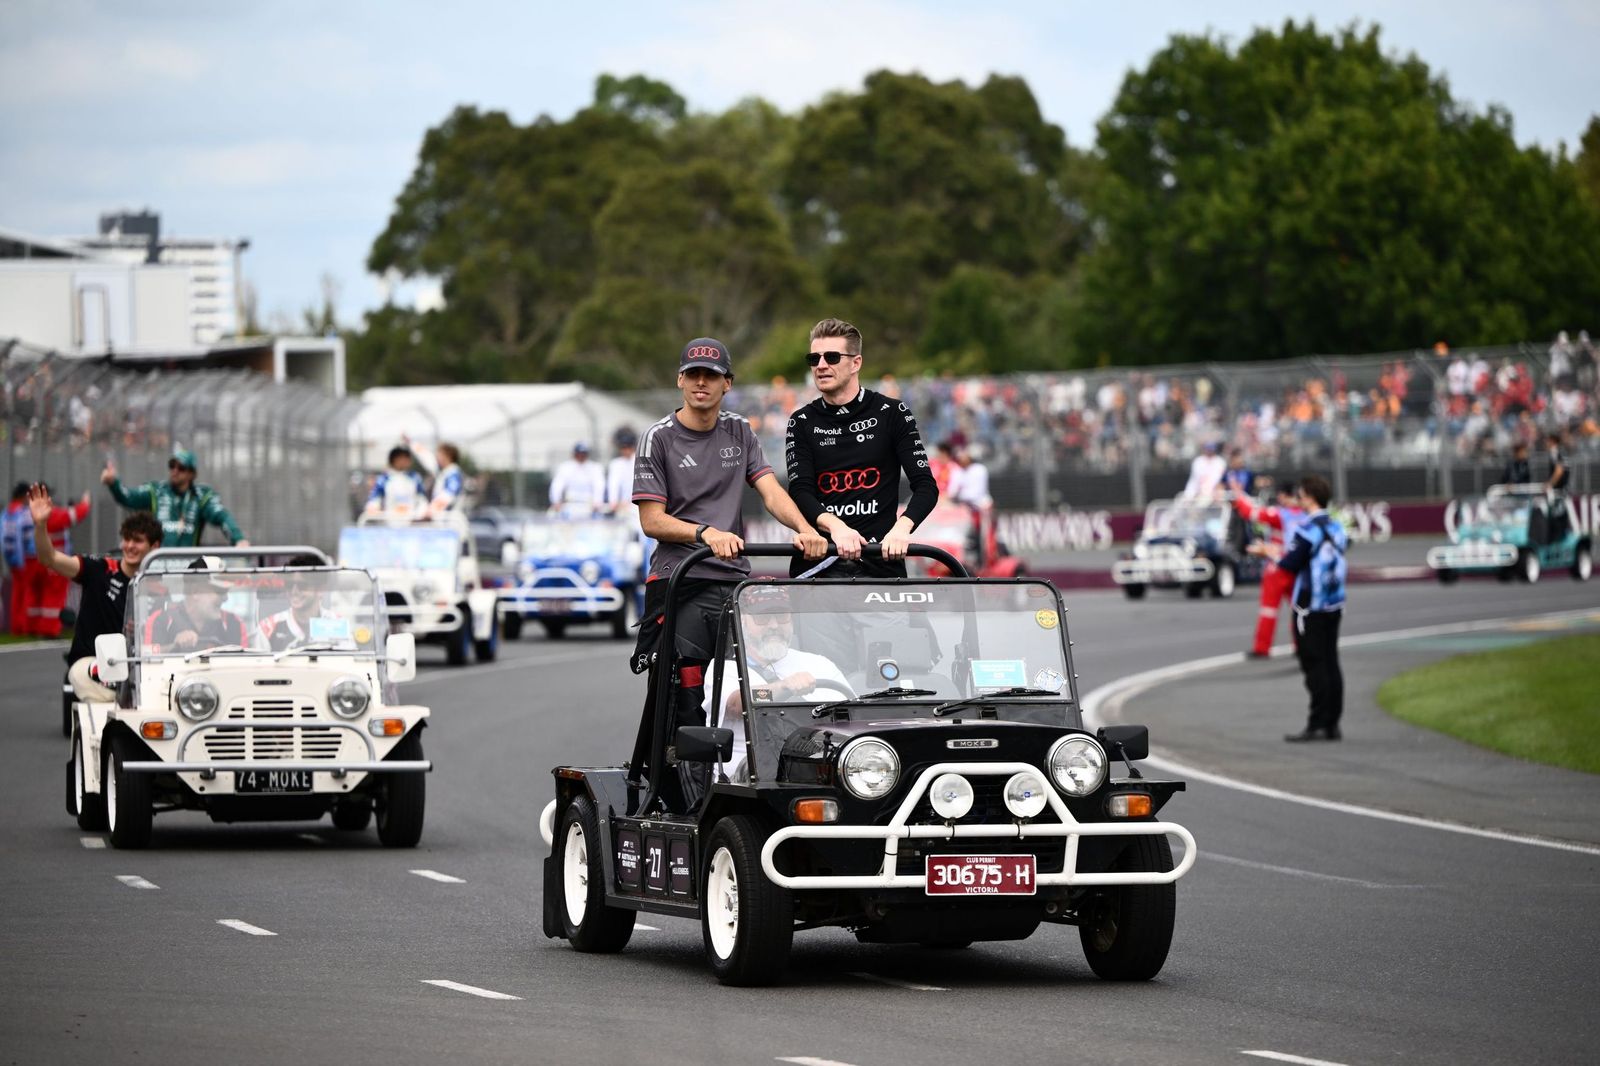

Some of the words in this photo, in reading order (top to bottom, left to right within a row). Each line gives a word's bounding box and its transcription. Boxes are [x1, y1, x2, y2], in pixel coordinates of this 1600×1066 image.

[814, 426, 842, 435] Revolut
[820, 499, 879, 517] evolut
[864, 591, 934, 603] AUDI
[650, 847, 662, 878] 27
